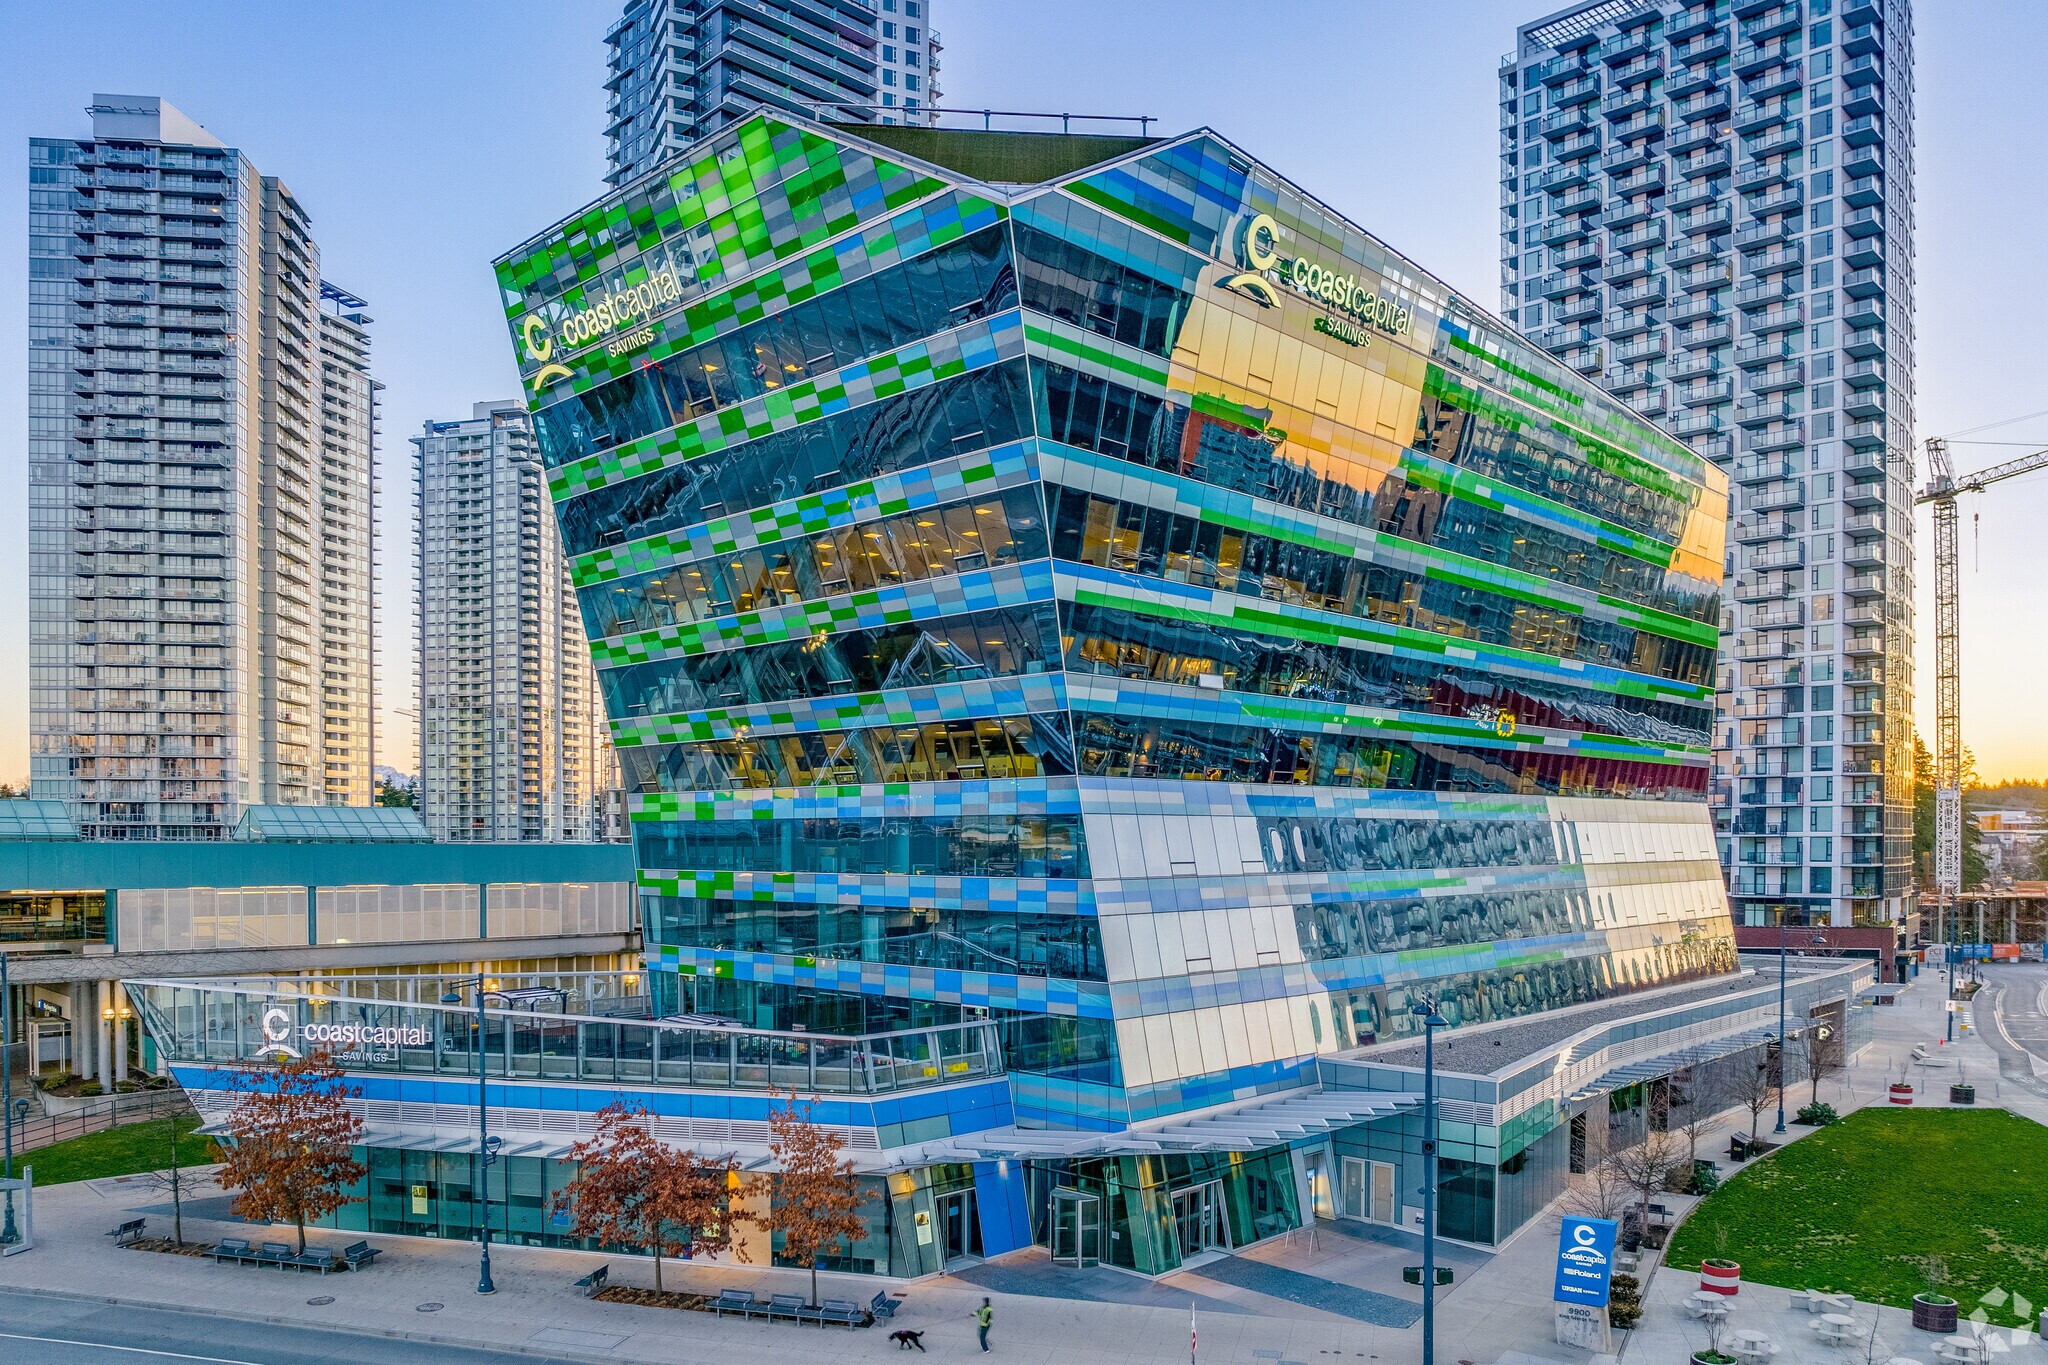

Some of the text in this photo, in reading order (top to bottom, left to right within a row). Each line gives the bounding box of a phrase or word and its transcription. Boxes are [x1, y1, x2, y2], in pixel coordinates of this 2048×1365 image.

[562, 261, 684, 346] coastcapital
[1293, 257, 1414, 335] coastcapital
[608, 327, 654, 358] SAVINGS
[1327, 317, 1372, 348] SAVINGS
[304, 1021, 425, 1051] coastcapital
[342, 1051, 387, 1063] SAVINGS
[1562, 1253, 1606, 1264] coastcapital
[1574, 1268, 1602, 1279] Roland
[1568, 1307, 1591, 1317] 9900
